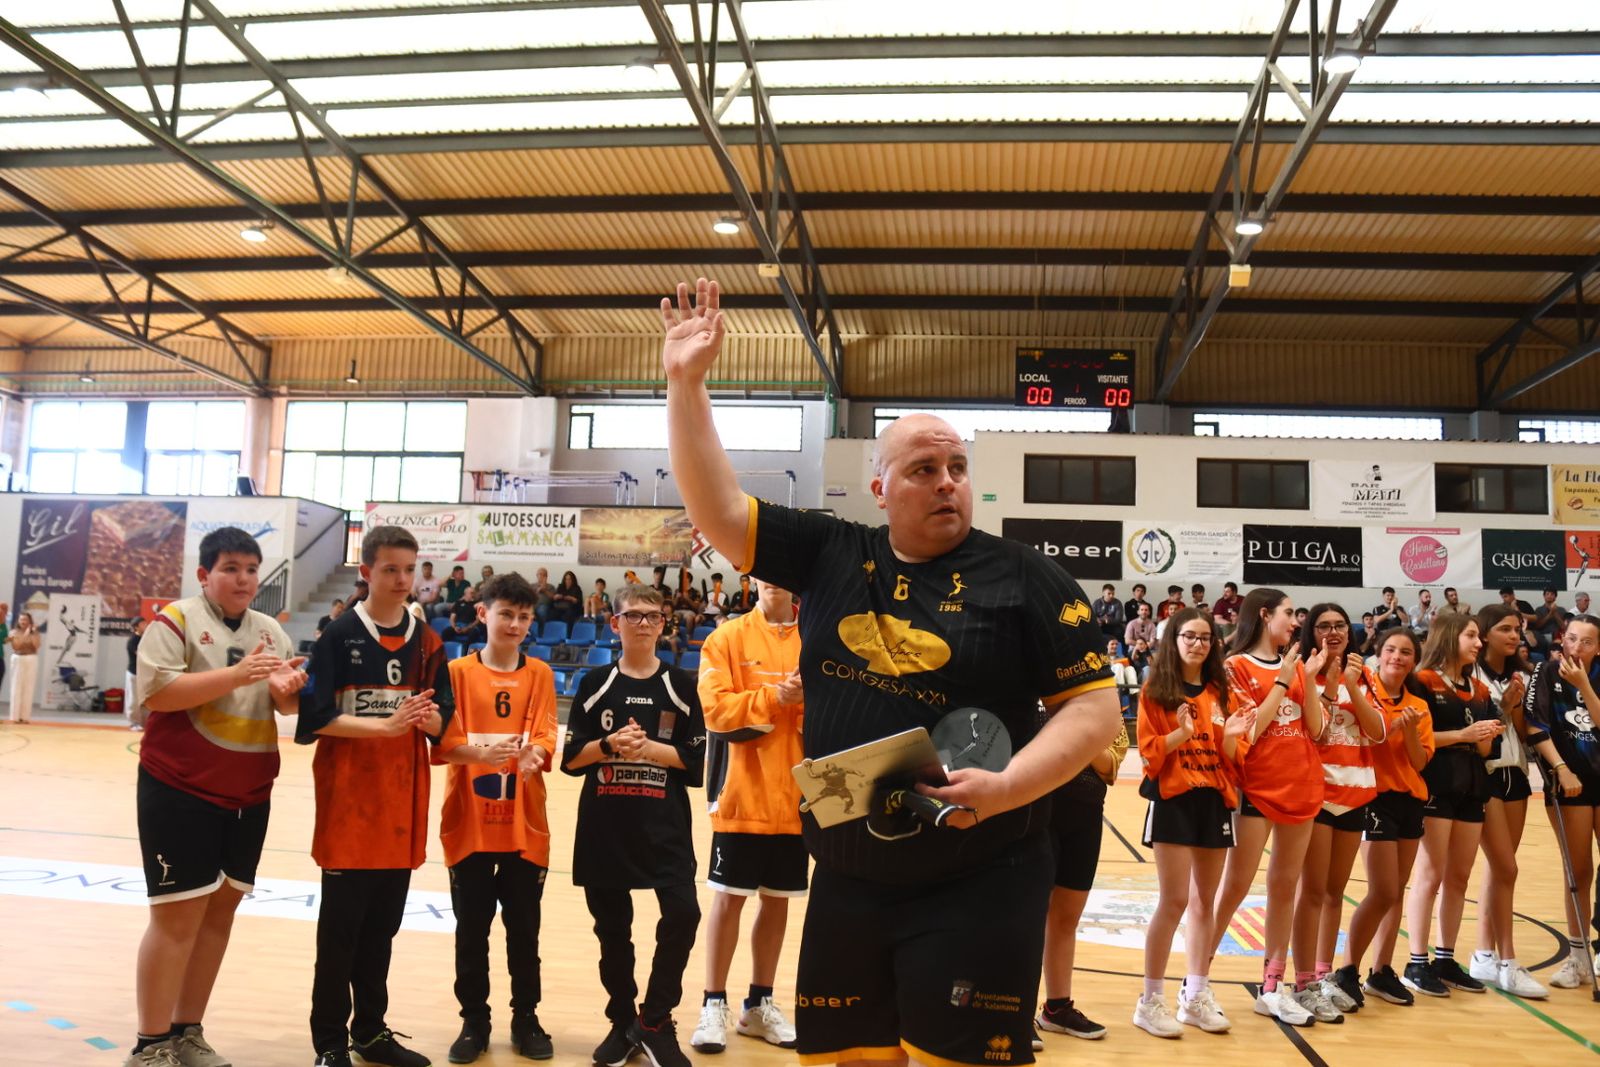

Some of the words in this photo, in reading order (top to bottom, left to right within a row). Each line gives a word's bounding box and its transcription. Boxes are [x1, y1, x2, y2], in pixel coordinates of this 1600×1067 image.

[1019, 373, 1050, 383] LOCAL
[1097, 375, 1128, 384] VISITANTE
[1026, 387, 1052, 405] 00
[1064, 397, 1087, 405] PERIODO
[1105, 388, 1131, 407] 00
[1353, 489, 1400, 501] MATI
[26, 502, 84, 547] Gil
[386, 515, 438, 527] CLINICA
[483, 512, 577, 528] AUTOESCUELA
[477, 529, 574, 547] SALAMANCA
[1035, 541, 1122, 558] beer
[387, 659, 402, 686] 6
[495, 691, 511, 718] 6
[601, 709, 614, 731] 6
[616, 768, 667, 783] panelais
